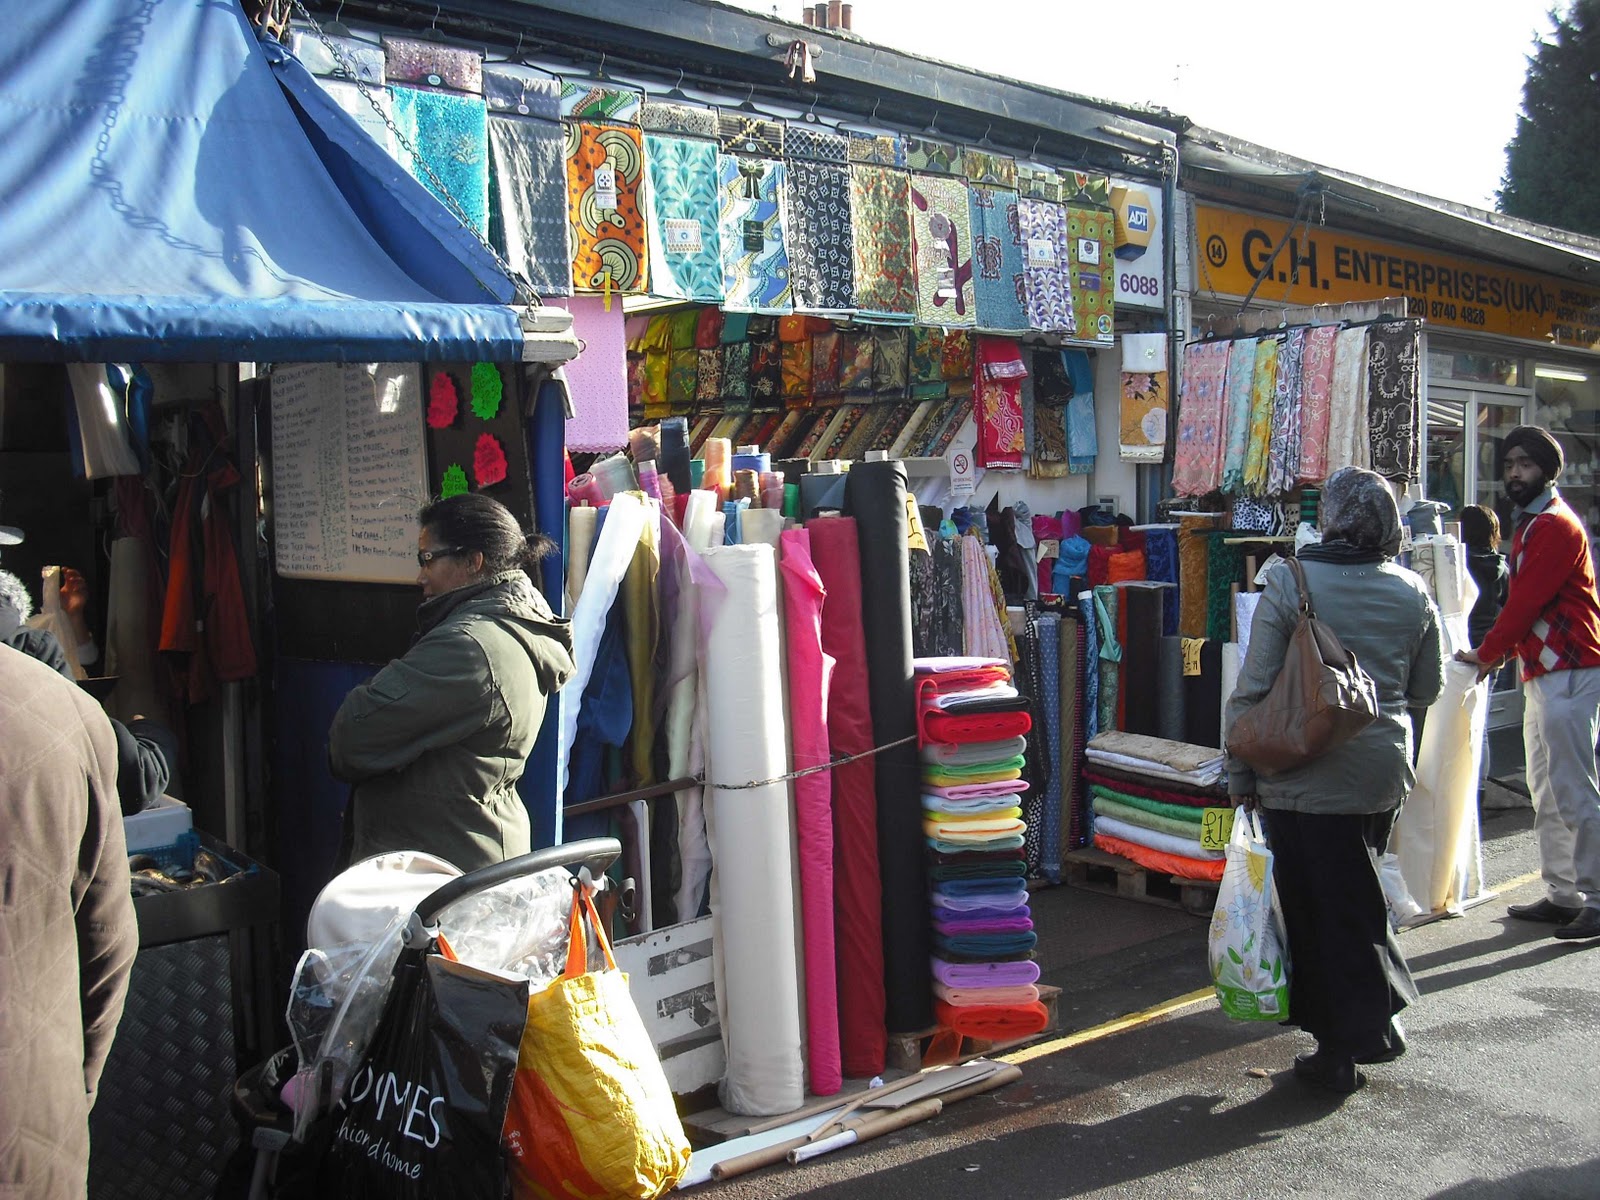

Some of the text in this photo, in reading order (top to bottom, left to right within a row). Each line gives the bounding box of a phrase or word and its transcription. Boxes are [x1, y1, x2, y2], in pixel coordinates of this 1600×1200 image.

[1128, 210, 1148, 227] ADT
[1211, 243, 1222, 259] 14
[1242, 229, 1330, 290] G.H.
[1120, 273, 1159, 296] 6088
[1431, 301, 1457, 321] 8740
[1461, 306, 1485, 326] 4828
[382, 1142, 421, 1178] home
